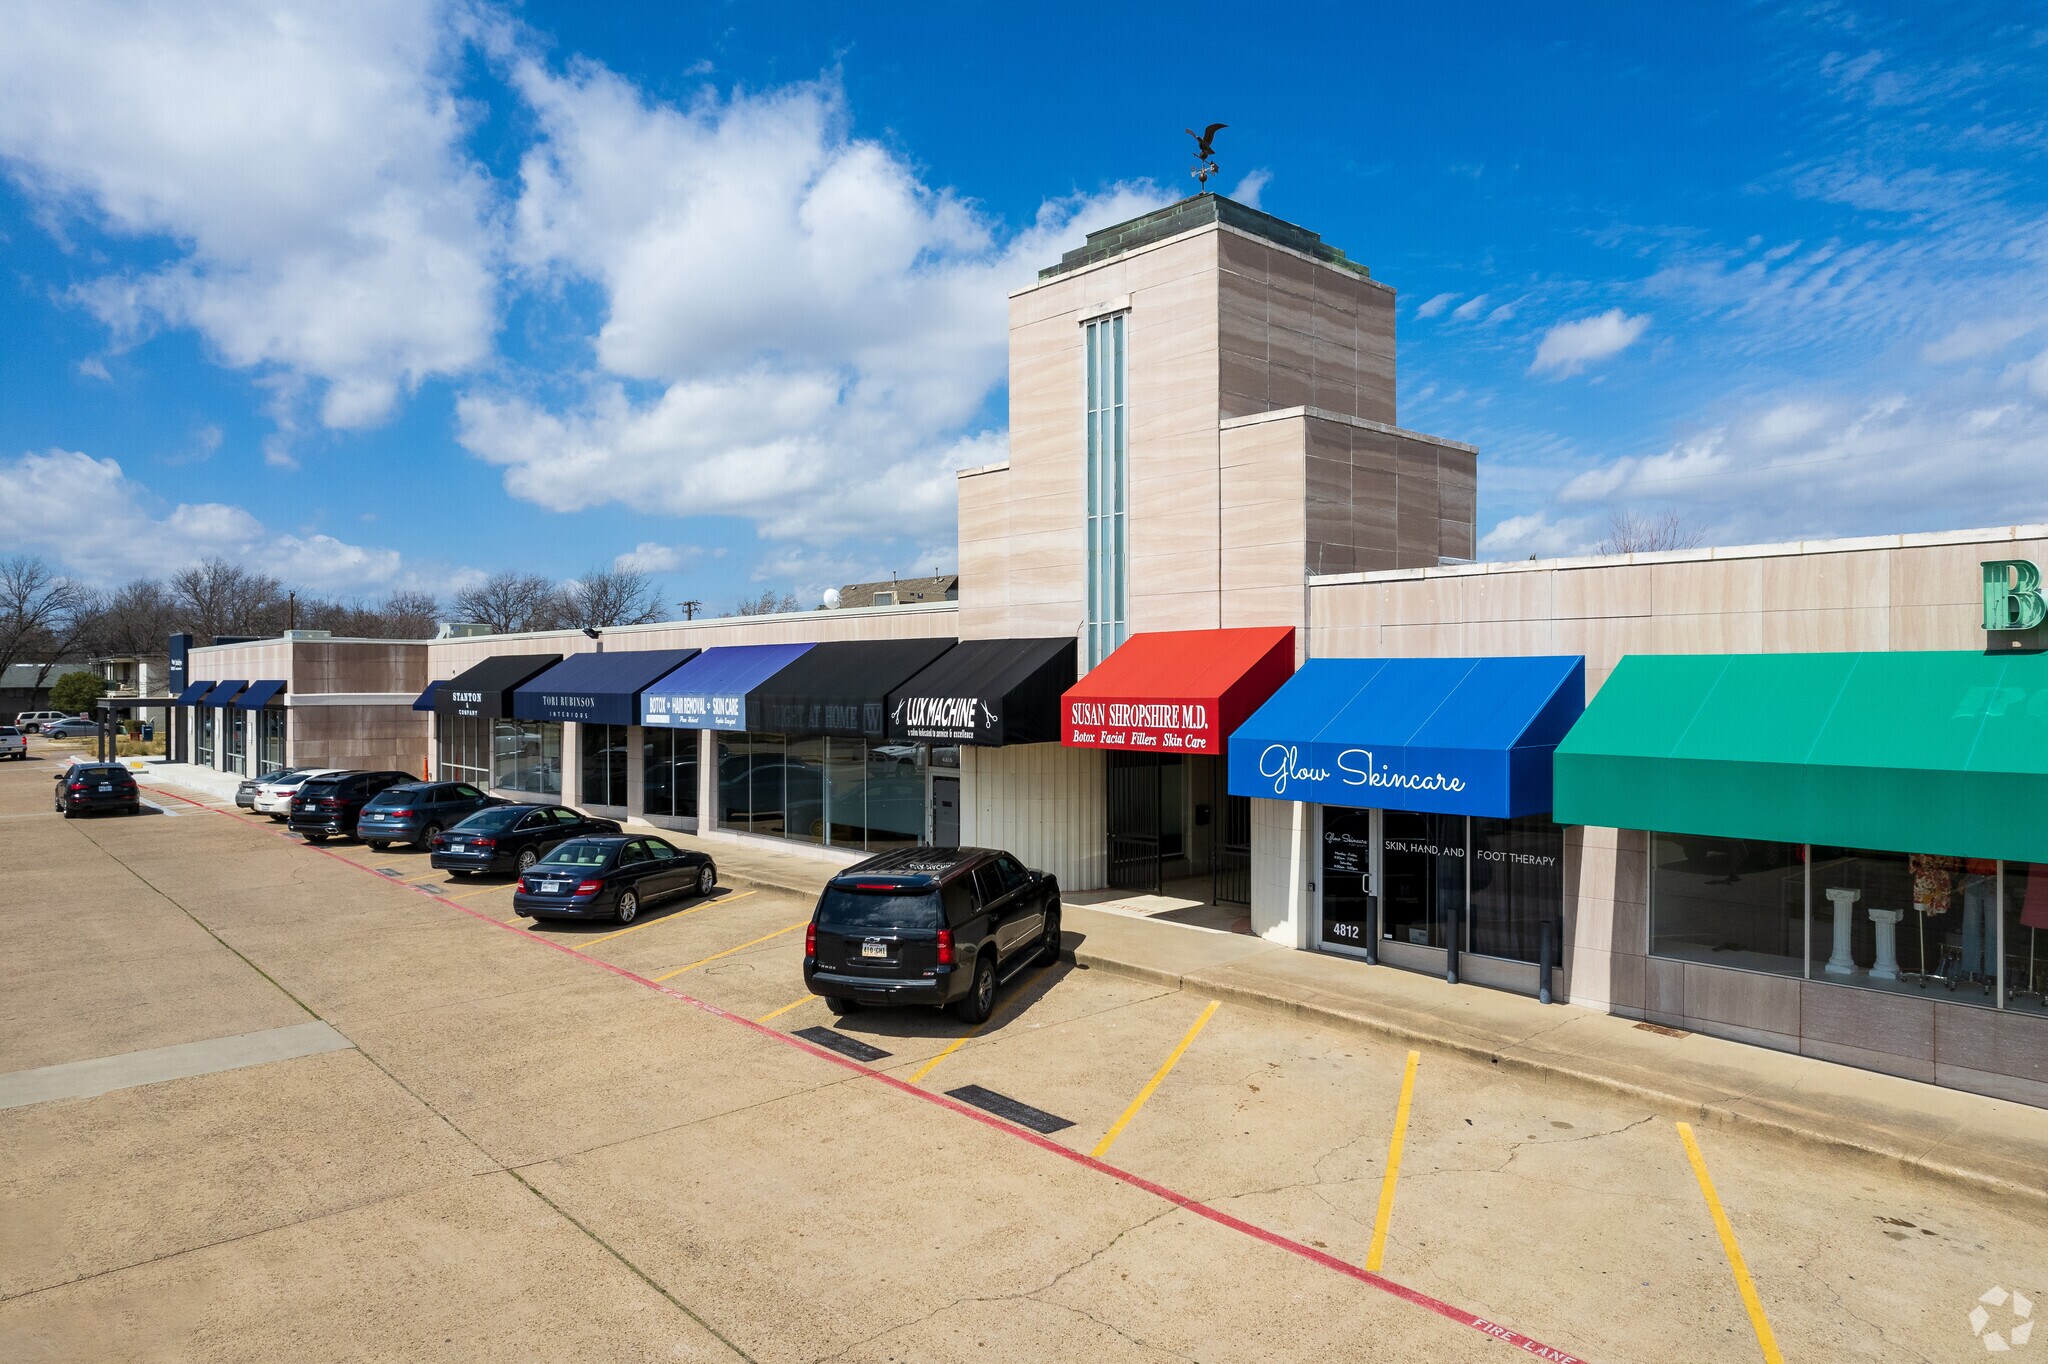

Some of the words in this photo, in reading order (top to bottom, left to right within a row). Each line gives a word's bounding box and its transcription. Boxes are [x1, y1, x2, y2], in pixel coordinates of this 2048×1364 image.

[1980, 560, 2046, 630] B
[452, 692, 482, 702] STANTON
[542, 696, 558, 706] TORI
[560, 696, 595, 708] RUBINSON
[649, 697, 666, 713] BOTOX
[671, 697, 683, 714] HAIR
[683, 698, 706, 714] REMOVAL
[712, 697, 724, 715] SKIN
[725, 698, 739, 715] CARE
[549, 711, 588, 719] INTERIORS
[808, 704, 821, 728] AT
[825, 705, 858, 729] HOME
[906, 698, 929, 726] LUX
[926, 698, 978, 728] MACHINE
[1072, 703, 1105, 725] SUSAN
[1109, 704, 1179, 728] SHROPSHIRE
[1181, 705, 1209, 729] M.D.
[1073, 730, 1095, 743] Botox
[1100, 731, 1126, 744] Facial
[1130, 732, 1157, 746] Fillers
[1162, 733, 1182, 747] Skin
[1185, 734, 1207, 749] Care
[1259, 744, 1331, 794] Glow
[1337, 749, 1466, 792] Skincare
[1385, 841, 1408, 853] SKIN,
[1410, 843, 1441, 856] HAND,
[1443, 847, 1465, 858] AND
[1477, 850, 1507, 861] FOOT
[1509, 853, 1556, 866] THERAPY
[1333, 923, 1359, 939] 4812
[1471, 1318, 1517, 1341] FIRE
